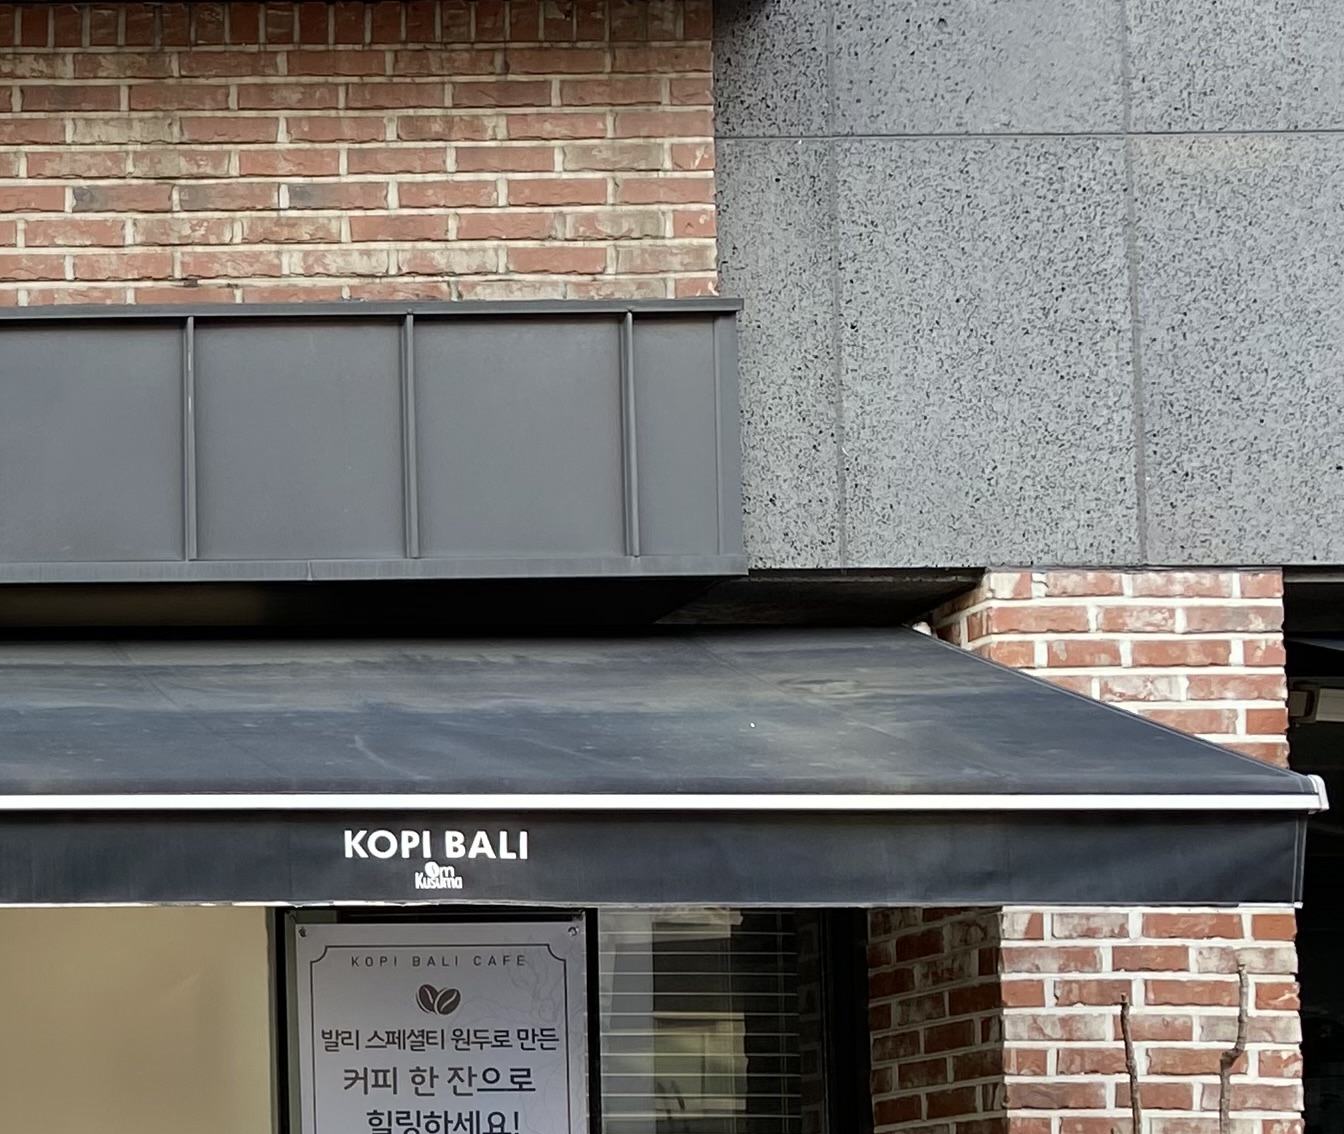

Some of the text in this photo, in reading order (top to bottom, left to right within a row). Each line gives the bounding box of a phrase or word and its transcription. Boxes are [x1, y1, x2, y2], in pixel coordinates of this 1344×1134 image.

[344, 830, 528, 859] KOPI BALI
[415, 872, 463, 889] Kusuma
[351, 954, 526, 967] KOPI BALI CAFE
[321, 1028, 559, 1052] 발리 스페셜티 원두로 만든
[343, 1065, 536, 1097] 커피 한 잔으로
